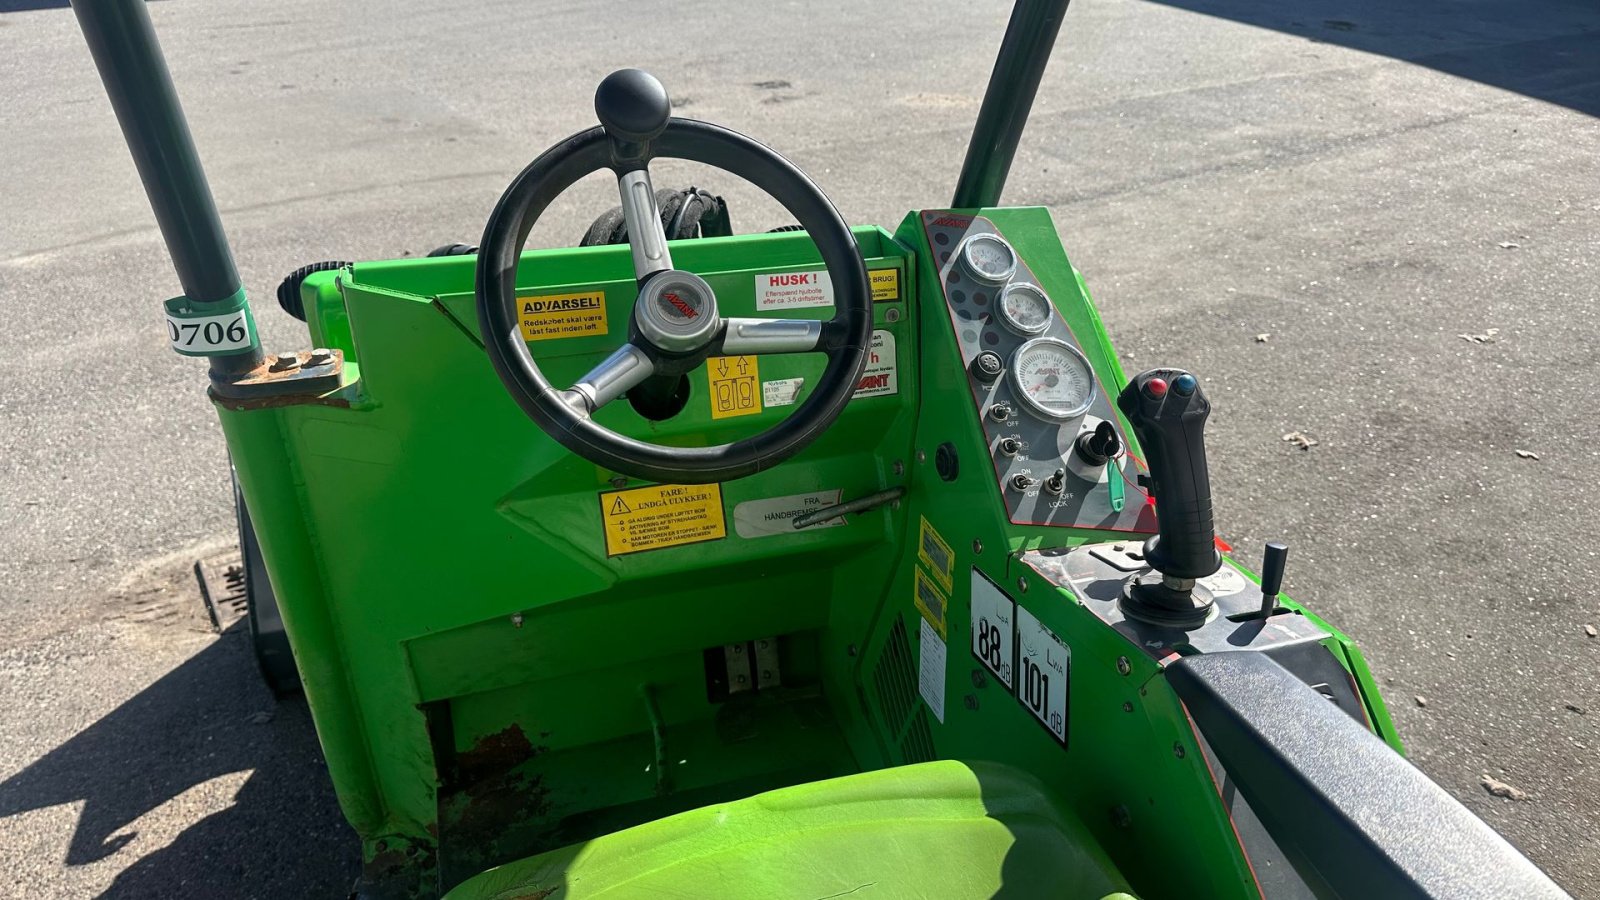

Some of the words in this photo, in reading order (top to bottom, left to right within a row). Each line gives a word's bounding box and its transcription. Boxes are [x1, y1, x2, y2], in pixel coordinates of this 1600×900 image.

[769, 273, 809, 286] HUSK
[813, 273, 817, 284] !
[523, 297, 600, 312] ADVARSEL!
[524, 318, 565, 327] Redskabet
[545, 326, 560, 334] fast
[562, 324, 583, 332] inden
[660, 488, 683, 498] FARE
[1027, 490, 1039, 498] OFF
[670, 493, 707, 505] ULYKKER
[804, 497, 820, 506] FRA
[978, 616, 1002, 673] 88
[1001, 662, 1011, 685] dB
[1023, 656, 1050, 722] 101
[1050, 709, 1062, 736] dB
